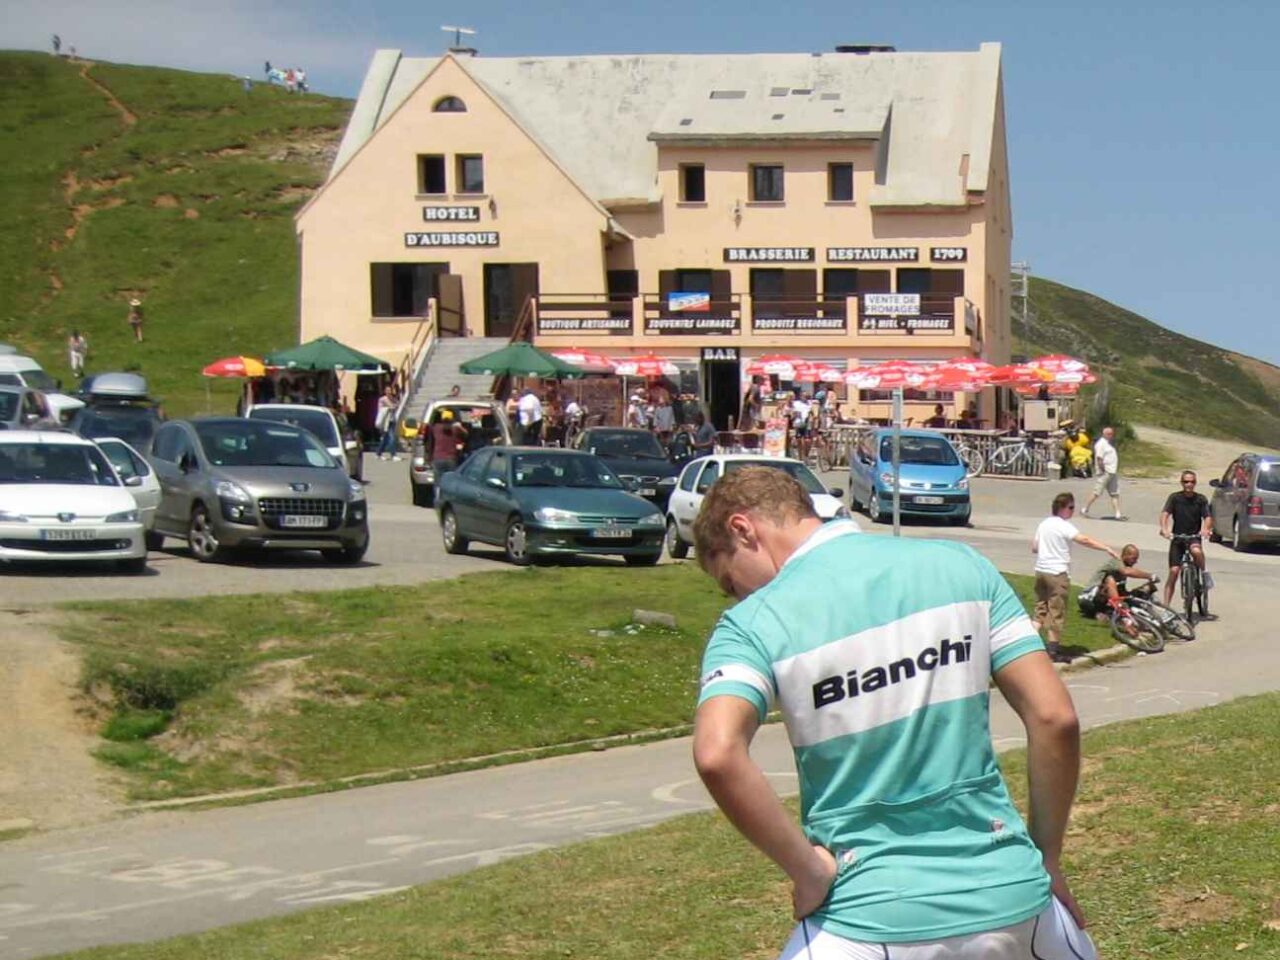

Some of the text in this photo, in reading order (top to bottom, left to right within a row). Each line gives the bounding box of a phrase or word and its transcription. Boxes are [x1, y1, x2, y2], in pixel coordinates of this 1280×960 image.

[425, 207, 477, 220] HOTEL
[406, 232, 497, 245] D'AUBISQUE
[728, 248, 964, 261] BRASSERIE RESTAURANT 1709
[868, 295, 917, 304] VENTE DE
[864, 304, 920, 314] FROMAGES
[539, 319, 630, 329] BOUTIQUE ARTISANALE
[648, 319, 694, 329] SOUVENIRS
[754, 319, 795, 328] PRODUITS
[877, 319, 950, 328] MIEL FROMAGES
[704, 348, 737, 360] BAR
[812, 635, 972, 710] Bianchi
